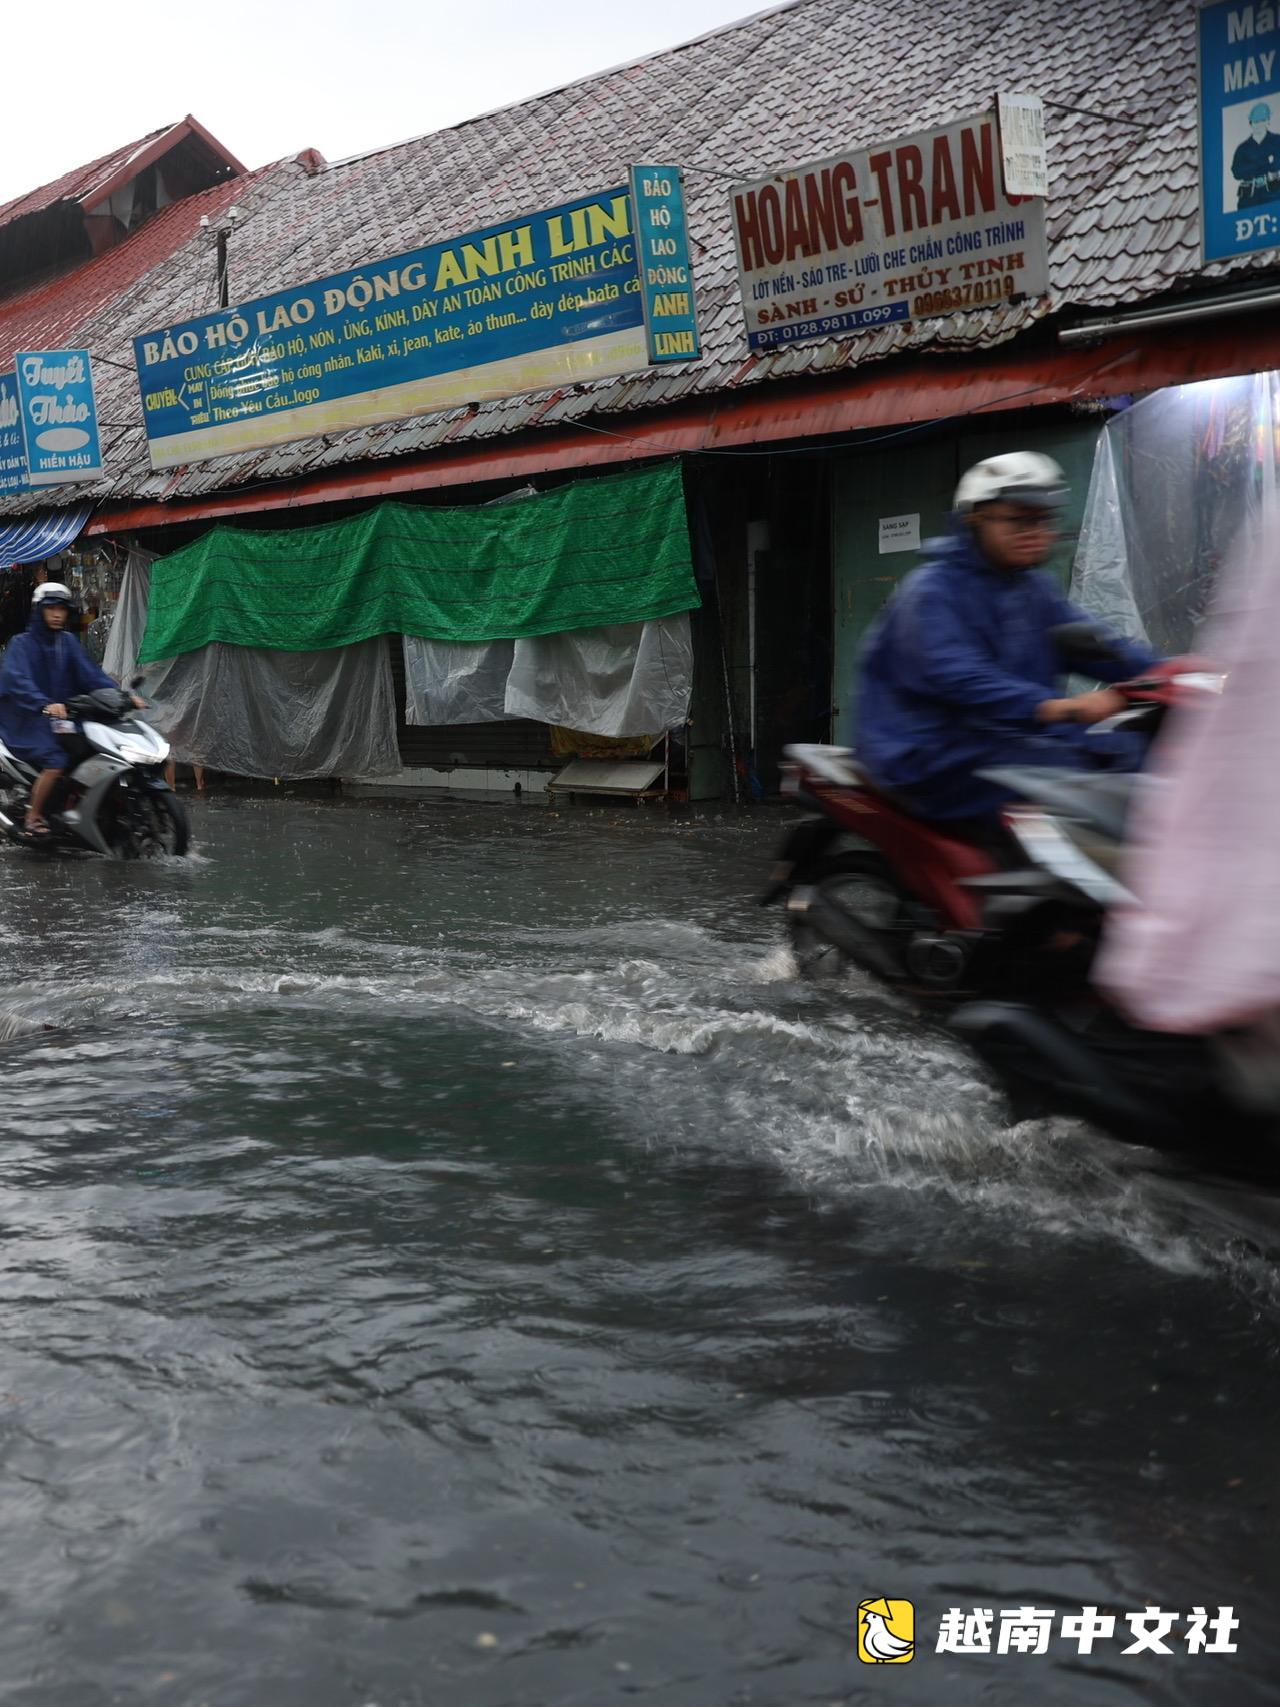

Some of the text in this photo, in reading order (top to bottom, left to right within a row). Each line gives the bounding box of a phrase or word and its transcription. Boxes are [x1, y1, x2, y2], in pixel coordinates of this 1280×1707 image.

[1227, 1, 1280, 44] Má
[1223, 50, 1276, 93] MAY
[643, 172, 672, 197] BẢO
[735, 122, 1033, 272] HOÀNG-TRAN
[650, 204, 671, 229] HỘ
[1235, 214, 1278, 241] ĐT:
[651, 239, 677, 257] LAO
[752, 279, 769, 301] LÓT
[826, 264, 847, 283] TRE
[884, 249, 906, 270] CHE
[946, 229, 982, 257] CÔNG
[985, 220, 1025, 246] TRÌNH
[143, 193, 636, 366] BẢO HỘ LAO ĐỘNG ANH LIN
[648, 264, 687, 289] ĐỘNG
[757, 251, 1025, 325] SÀNH SỨ THỦY TINH
[184, 363, 212, 382] CUNG
[412, 298, 439, 322] DÂY
[442, 294, 462, 314] AN
[465, 280, 502, 306] TOÀN
[506, 269, 546, 296] CÔNG
[549, 255, 596, 282] TRÌNH
[600, 242, 634, 270] CÁC
[652, 292, 689, 317] ANH
[281, 368, 295, 382] hộ
[297, 362, 322, 381] công
[356, 344, 385, 366] Kaki,
[402, 335, 432, 357] jean,
[435, 326, 465, 344] kate,
[468, 318, 483, 335] áo
[530, 301, 554, 321] dày
[558, 292, 582, 313] dép
[587, 284, 619, 306] bata
[623, 274, 641, 293] cá
[654, 331, 694, 356] LINH
[756, 330, 779, 346] ĐT:
[783, 307, 892, 340] 0128.9811.099
[22, 355, 86, 390] Tuyết
[29, 394, 91, 426] Thảo
[212, 406, 239, 421] Theo
